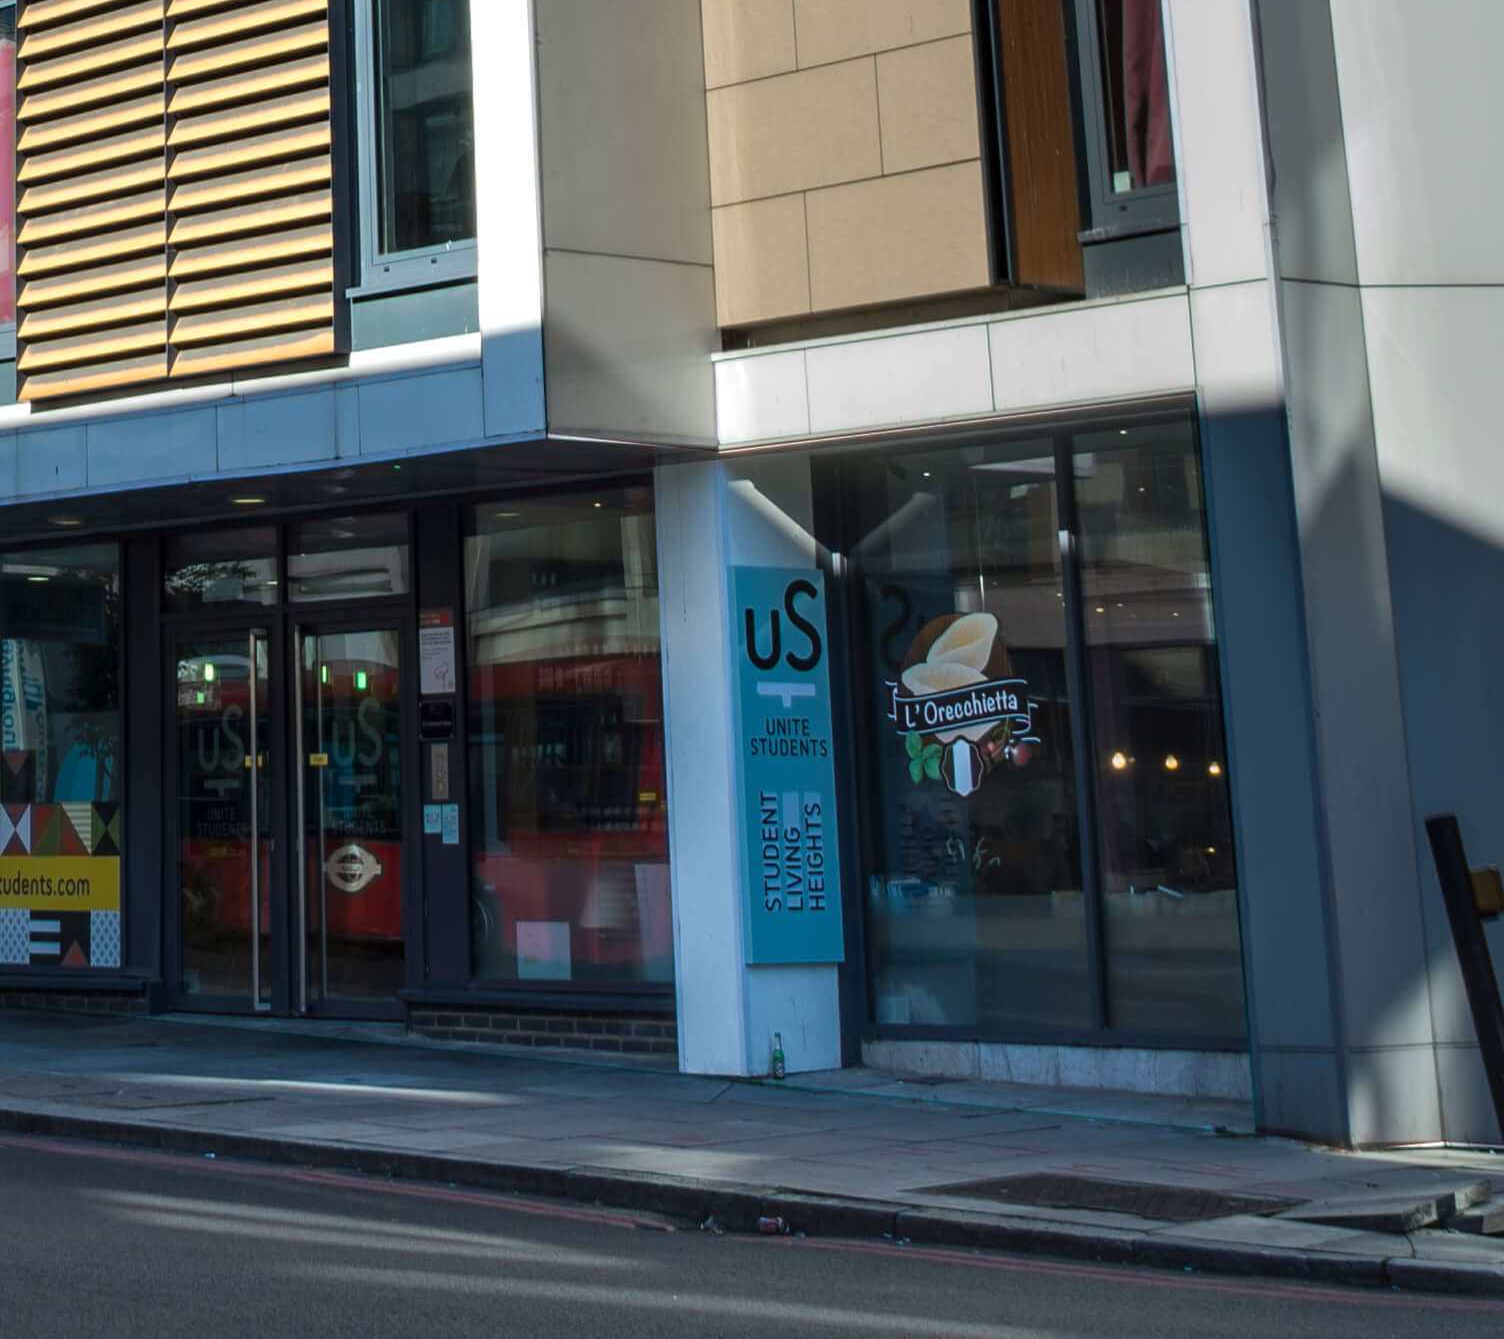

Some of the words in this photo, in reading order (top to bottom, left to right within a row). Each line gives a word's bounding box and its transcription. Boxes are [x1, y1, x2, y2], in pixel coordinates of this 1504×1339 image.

[750, 738, 829, 757] STUDENTS
[765, 718, 810, 737] UNITE
[760, 790, 782, 912] STUDENT
[783, 826, 804, 911] LIVING
[804, 802, 826, 911] HEIGHTS
